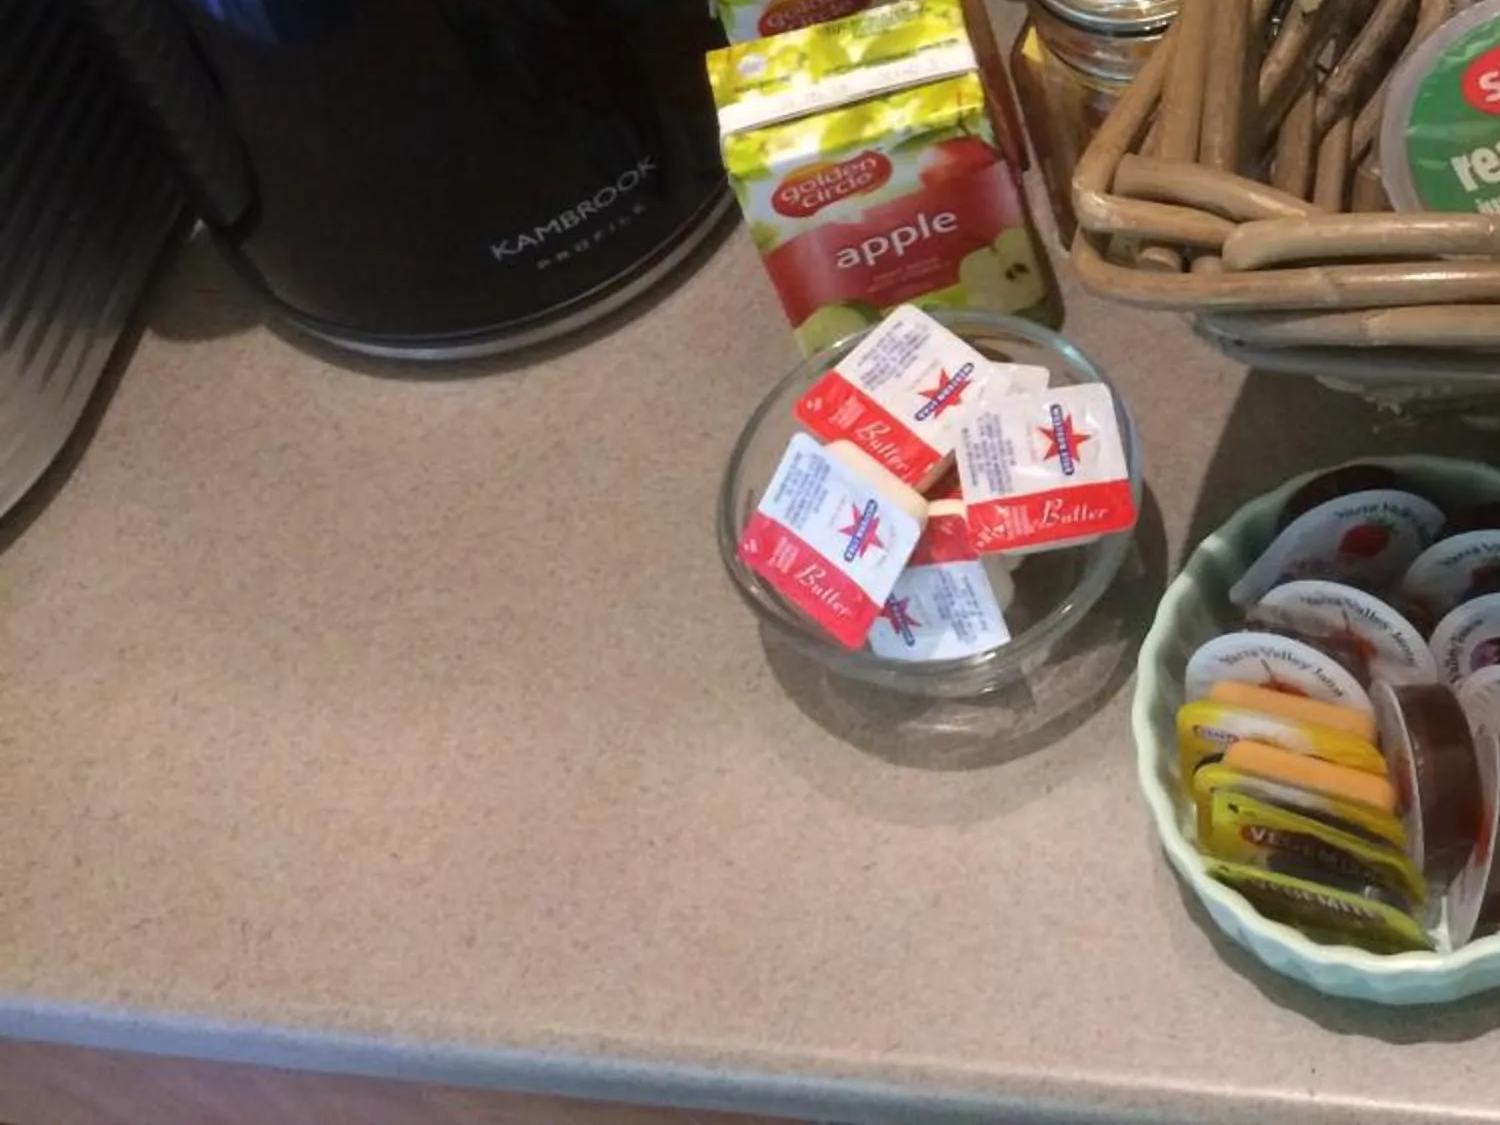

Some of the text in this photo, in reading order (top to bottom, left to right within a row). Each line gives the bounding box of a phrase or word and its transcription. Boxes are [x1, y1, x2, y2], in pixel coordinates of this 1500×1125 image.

[781, 155, 878, 204] golden
[801, 172, 873, 209] circle
[489, 155, 657, 261] KAMBROOK
[835, 210, 959, 270] apple
[854, 419, 910, 473] Butter
[1040, 498, 1109, 526] Butter
[795, 563, 853, 617] Butter
